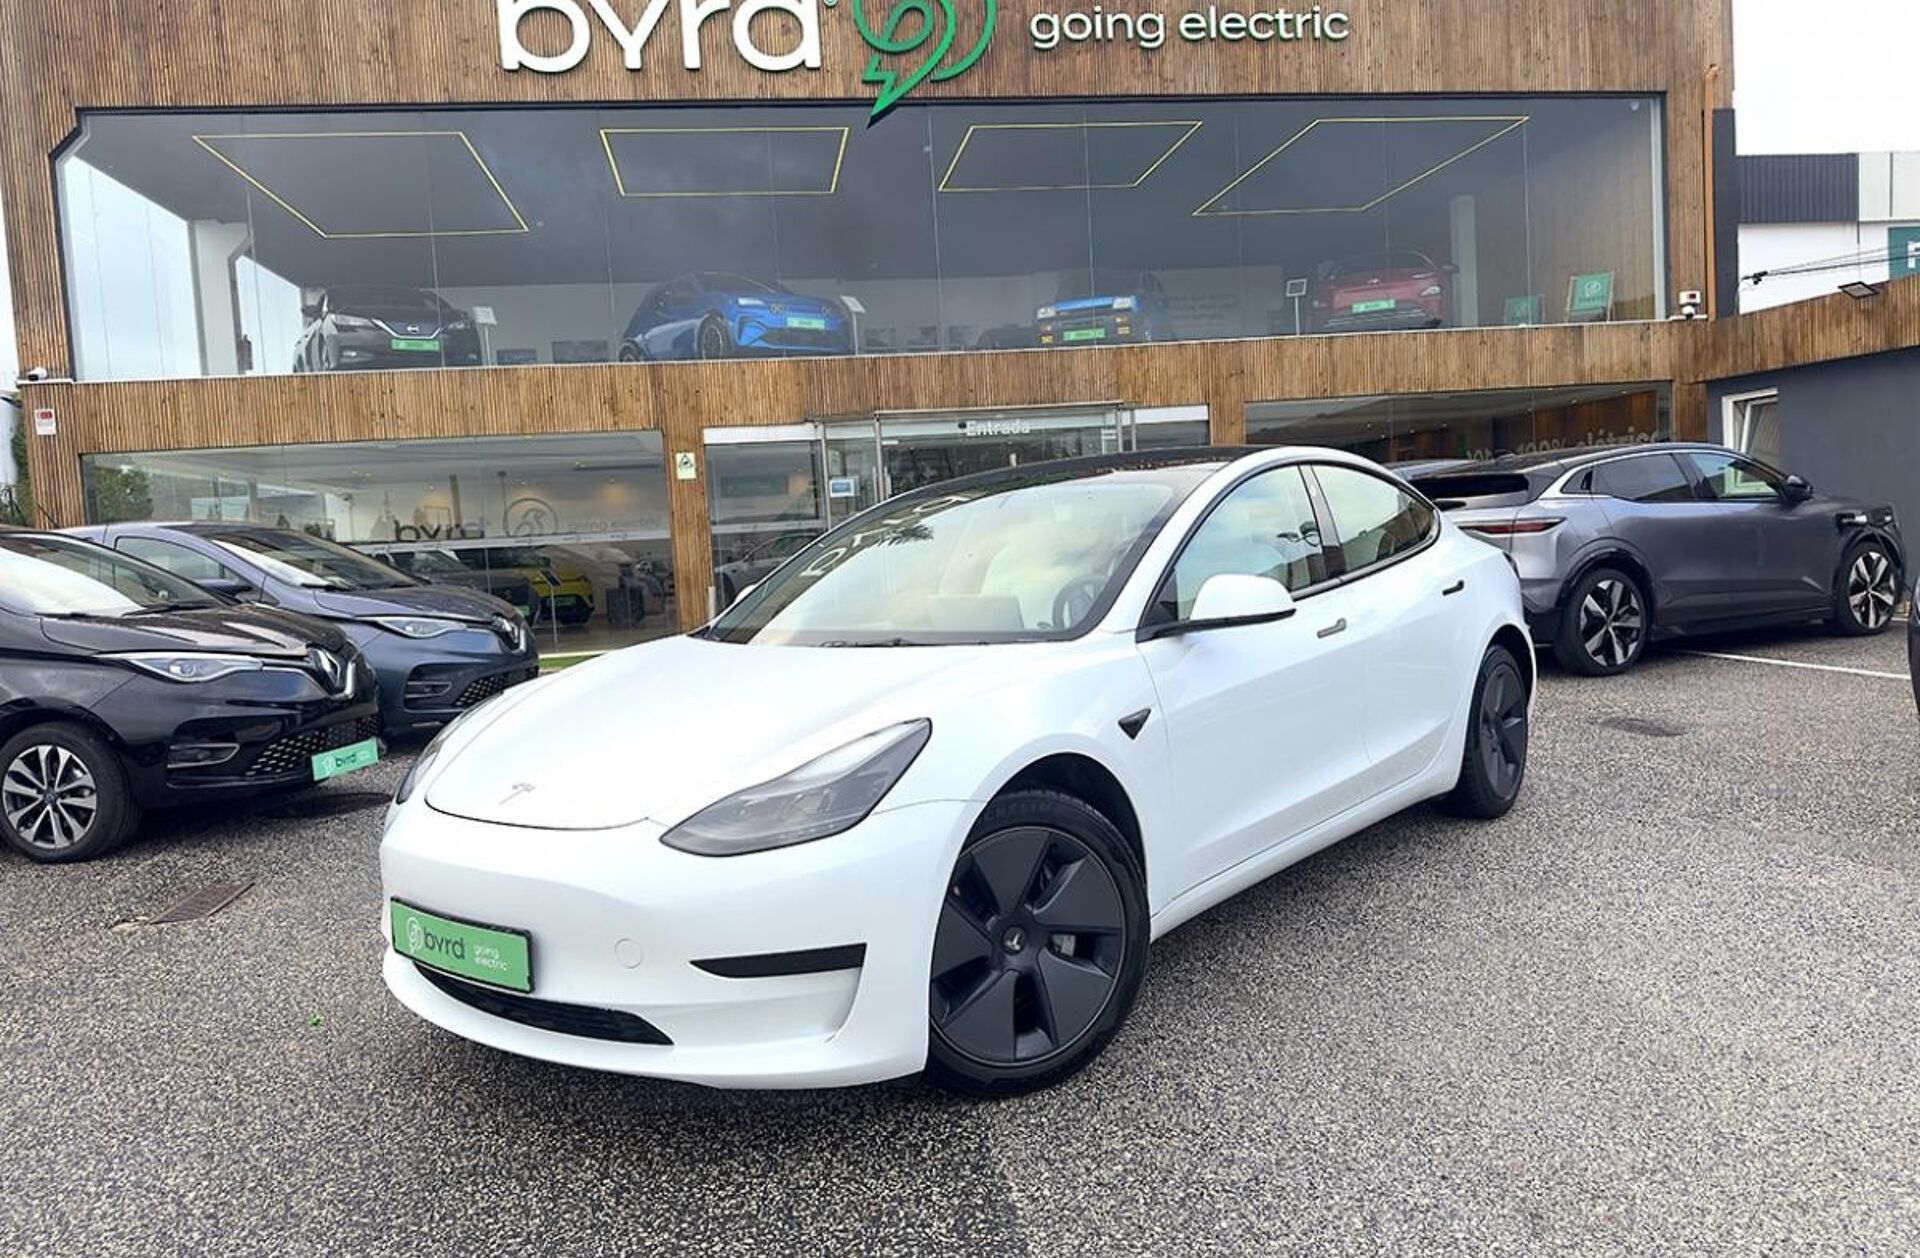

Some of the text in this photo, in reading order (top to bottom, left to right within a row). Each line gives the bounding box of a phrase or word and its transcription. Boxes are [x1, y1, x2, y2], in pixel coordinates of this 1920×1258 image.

[1029, 5, 1349, 49] going electric
[966, 419, 1031, 437] Entrada
[423, 928, 466, 960] byrd
